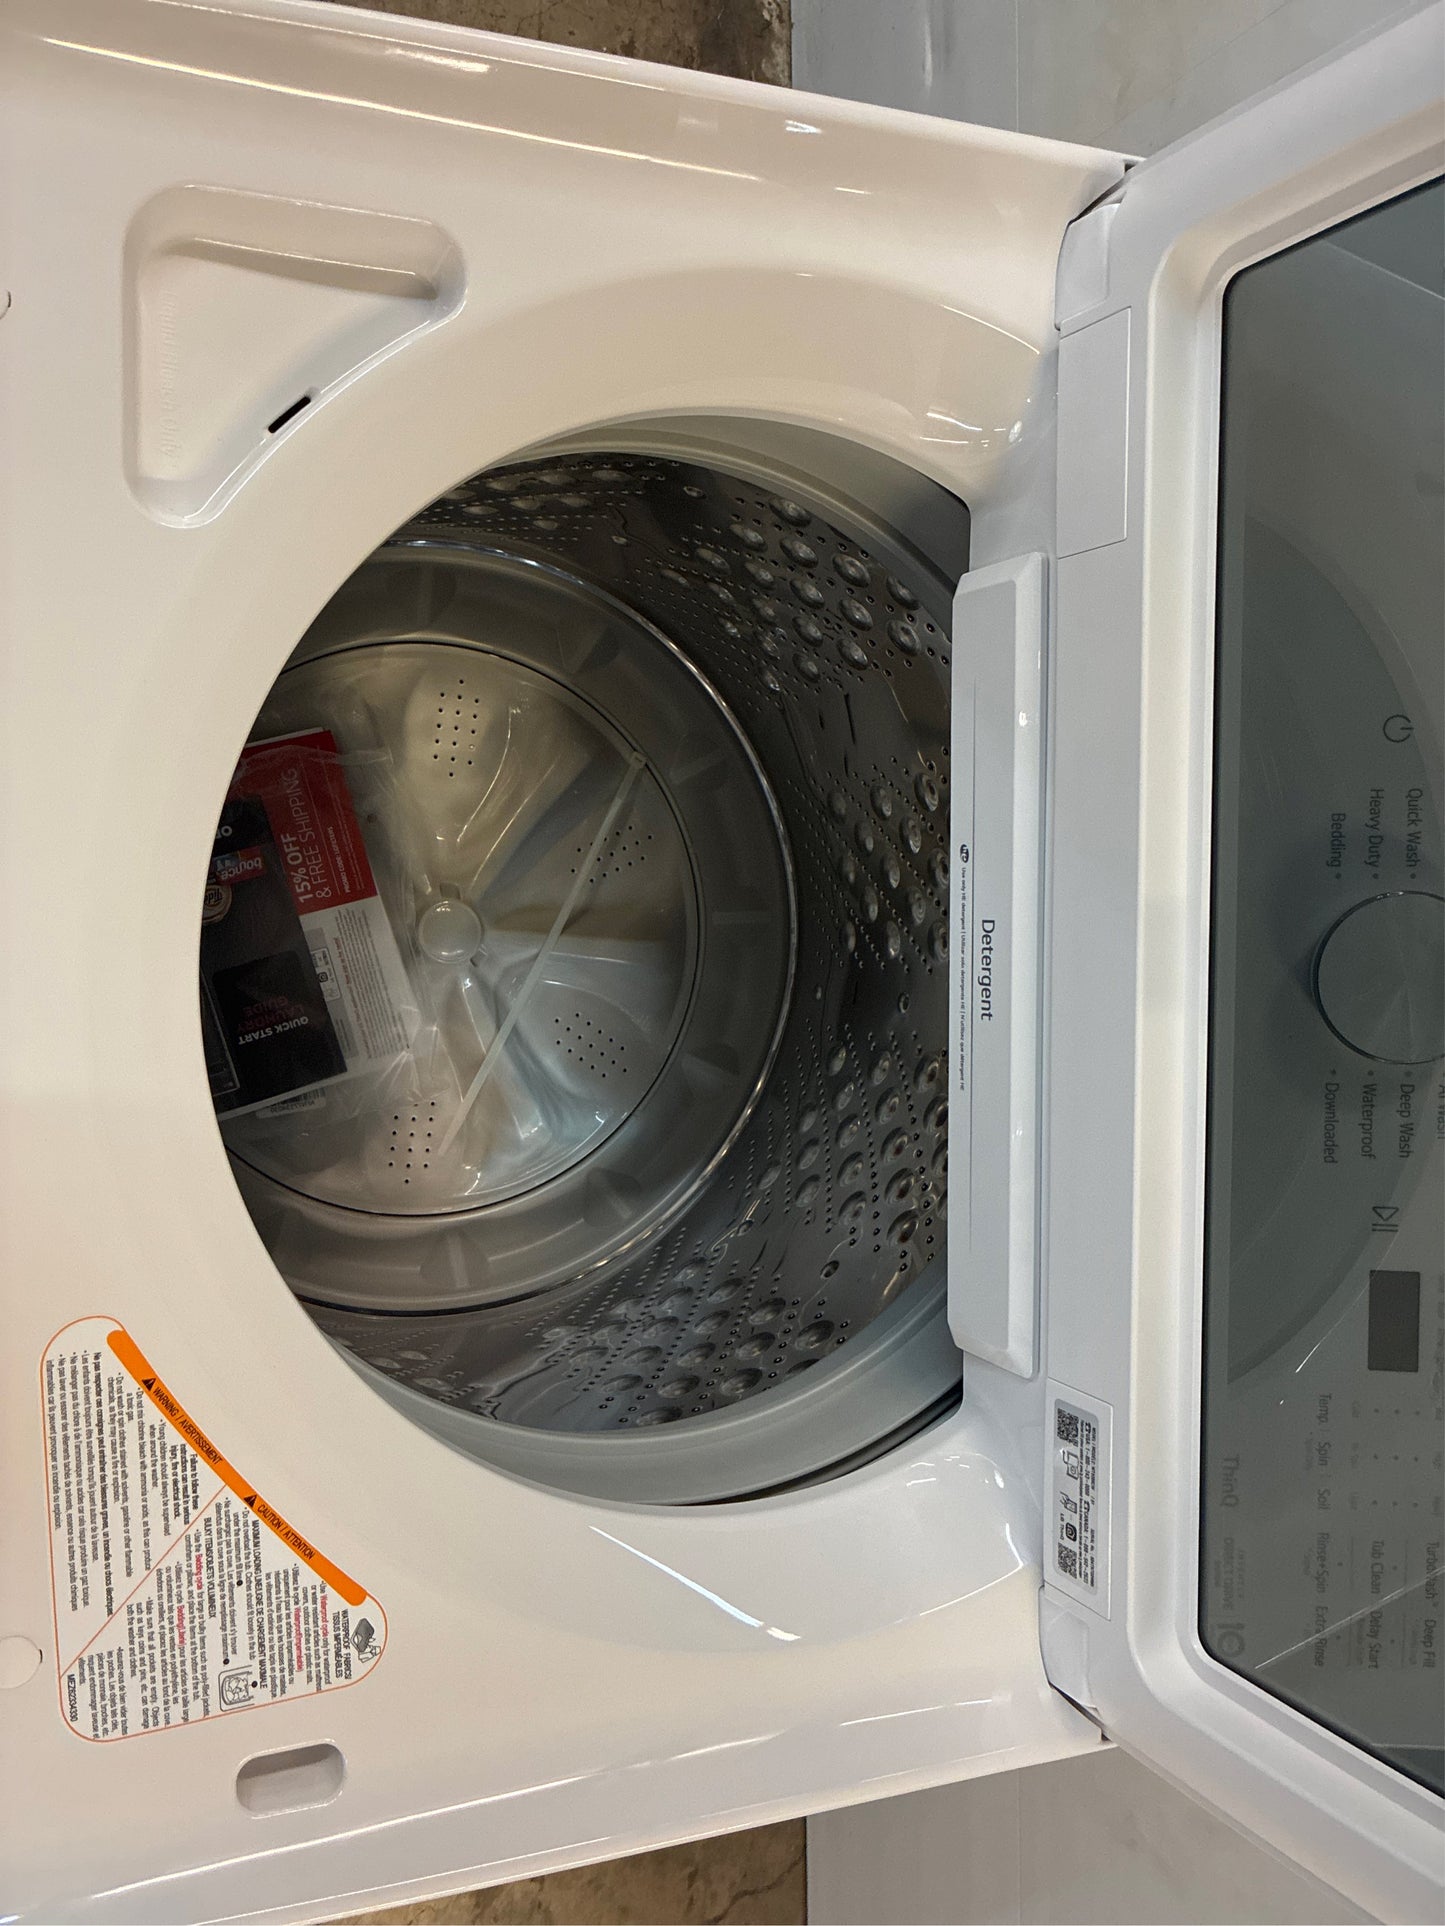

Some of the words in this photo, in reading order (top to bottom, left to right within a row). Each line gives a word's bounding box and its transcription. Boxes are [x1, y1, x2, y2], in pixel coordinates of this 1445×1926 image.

[280, 768, 315, 843] SHIPPING
[1364, 788, 1383, 831] Heavy
[1404, 788, 1424, 826] Quick
[280, 833, 302, 865] OFF
[1328, 813, 1347, 868] Bedding
[1364, 834, 1382, 868] Duty
[1406, 830, 1422, 868] Wash
[220, 858, 262, 880] bounce
[303, 845, 327, 884] FREE
[290, 868, 314, 903] 15%
[316, 887, 332, 898] &
[978, 919, 996, 1021] Detergent
[238, 1028, 272, 1045] START
[274, 1015, 309, 1031] QUICK
[1396, 1084, 1415, 1122] Deep
[1323, 1082, 1340, 1164] Downloaded
[1359, 1084, 1377, 1159] Waterproof
[1399, 1124, 1414, 1158] Wash
[153, 1387, 180, 1417] WARNING
[175, 1420, 223, 1465] AVERTISSEMENT
[1316, 1442, 1330, 1466] Spin
[1219, 1454, 1240, 1508] ThinQ
[1317, 1488, 1330, 1510] Soil
[257, 1504, 283, 1529] CAUTION
[282, 1531, 315, 1560] ATTENTION
[1371, 1540, 1384, 1558] Tub
[1315, 1532, 1330, 1593] Rinse+Spin
[1370, 1562, 1384, 1594] Clean
[1367, 1610, 1383, 1640] Delay
[1422, 1619, 1436, 1648] Deep
[1314, 1638, 1328, 1667] Rinse
[1368, 1642, 1381, 1670] Start
[1422, 1650, 1436, 1668] Fill
